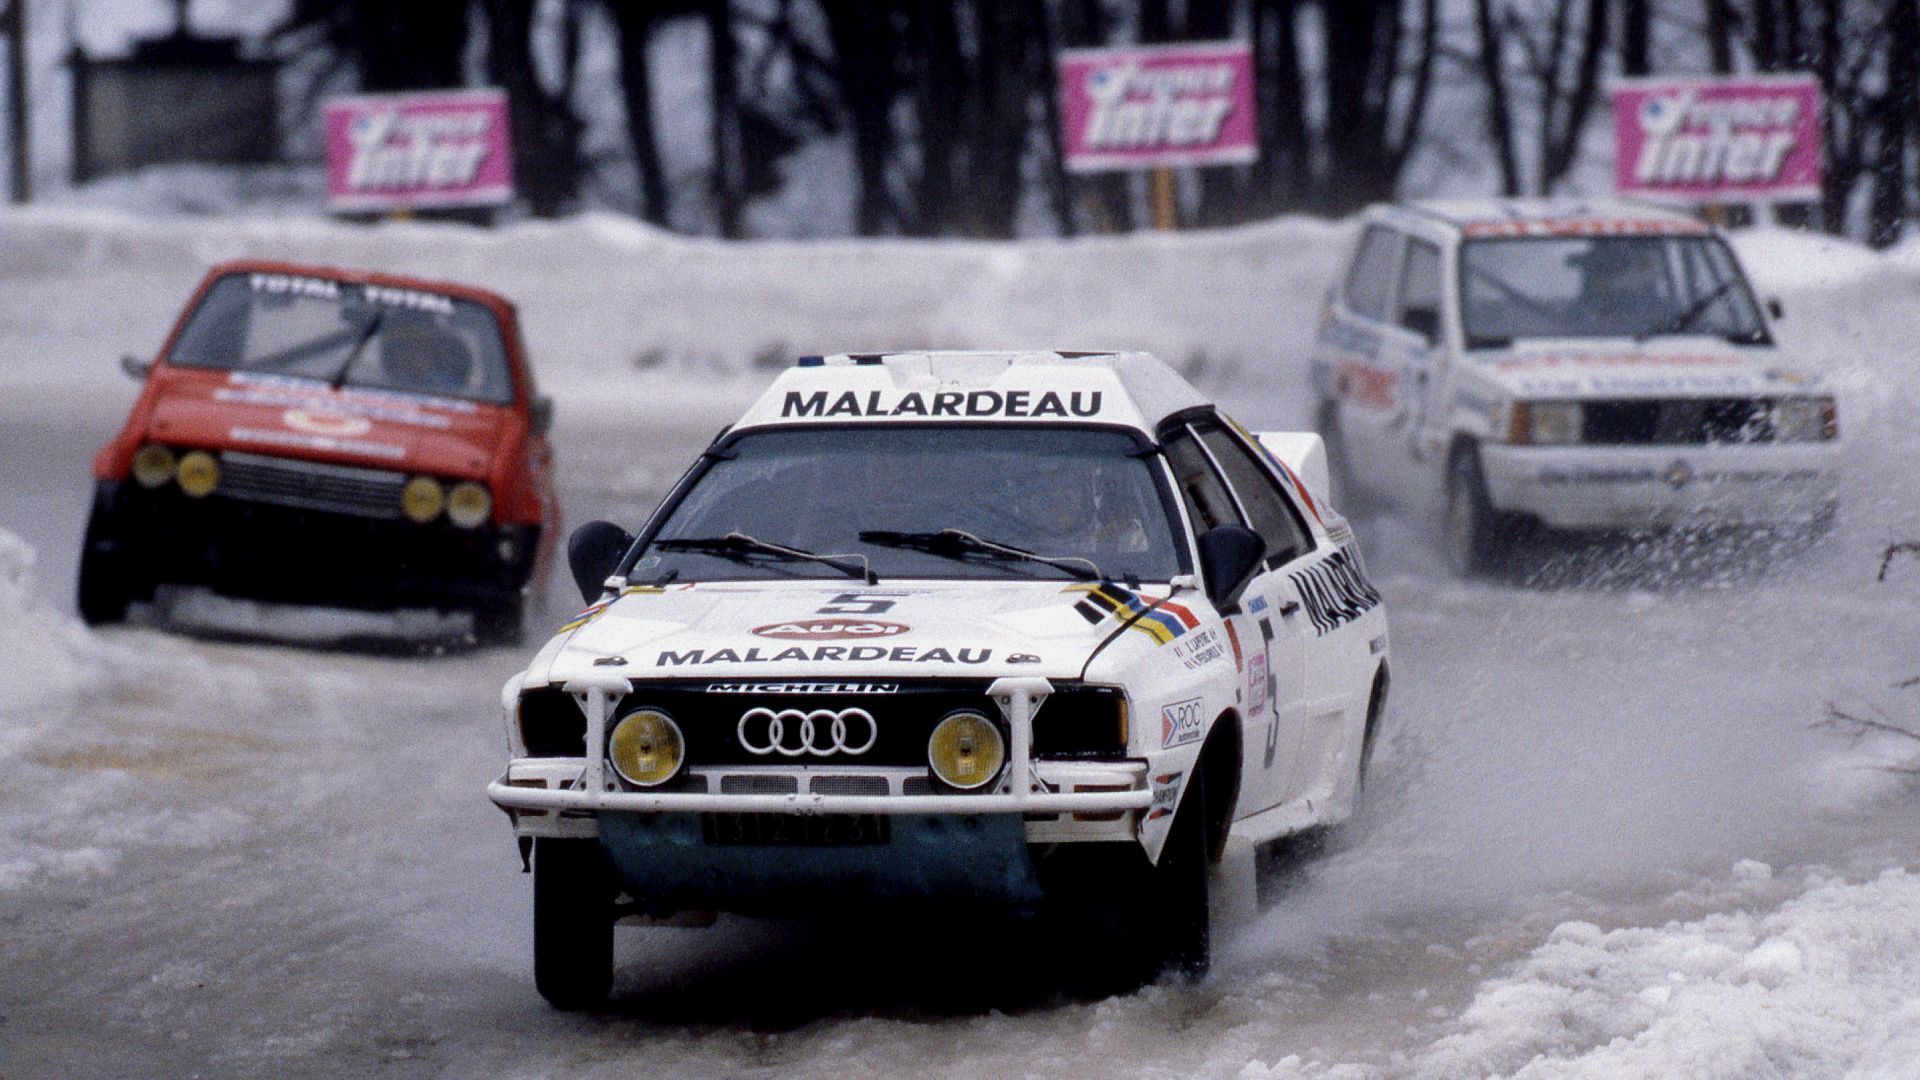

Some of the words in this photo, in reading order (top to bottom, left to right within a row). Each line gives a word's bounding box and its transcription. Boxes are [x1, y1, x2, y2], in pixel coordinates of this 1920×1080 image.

[251, 274, 338, 299] TOTAL
[364, 285, 454, 315] TOTAL
[781, 390, 1102, 417] MALARDEAU
[815, 593, 911, 614] 5
[656, 646, 993, 667] MALARDEAU
[707, 683, 899, 694] MICHELIN
[1179, 702, 1200, 730] ROC
